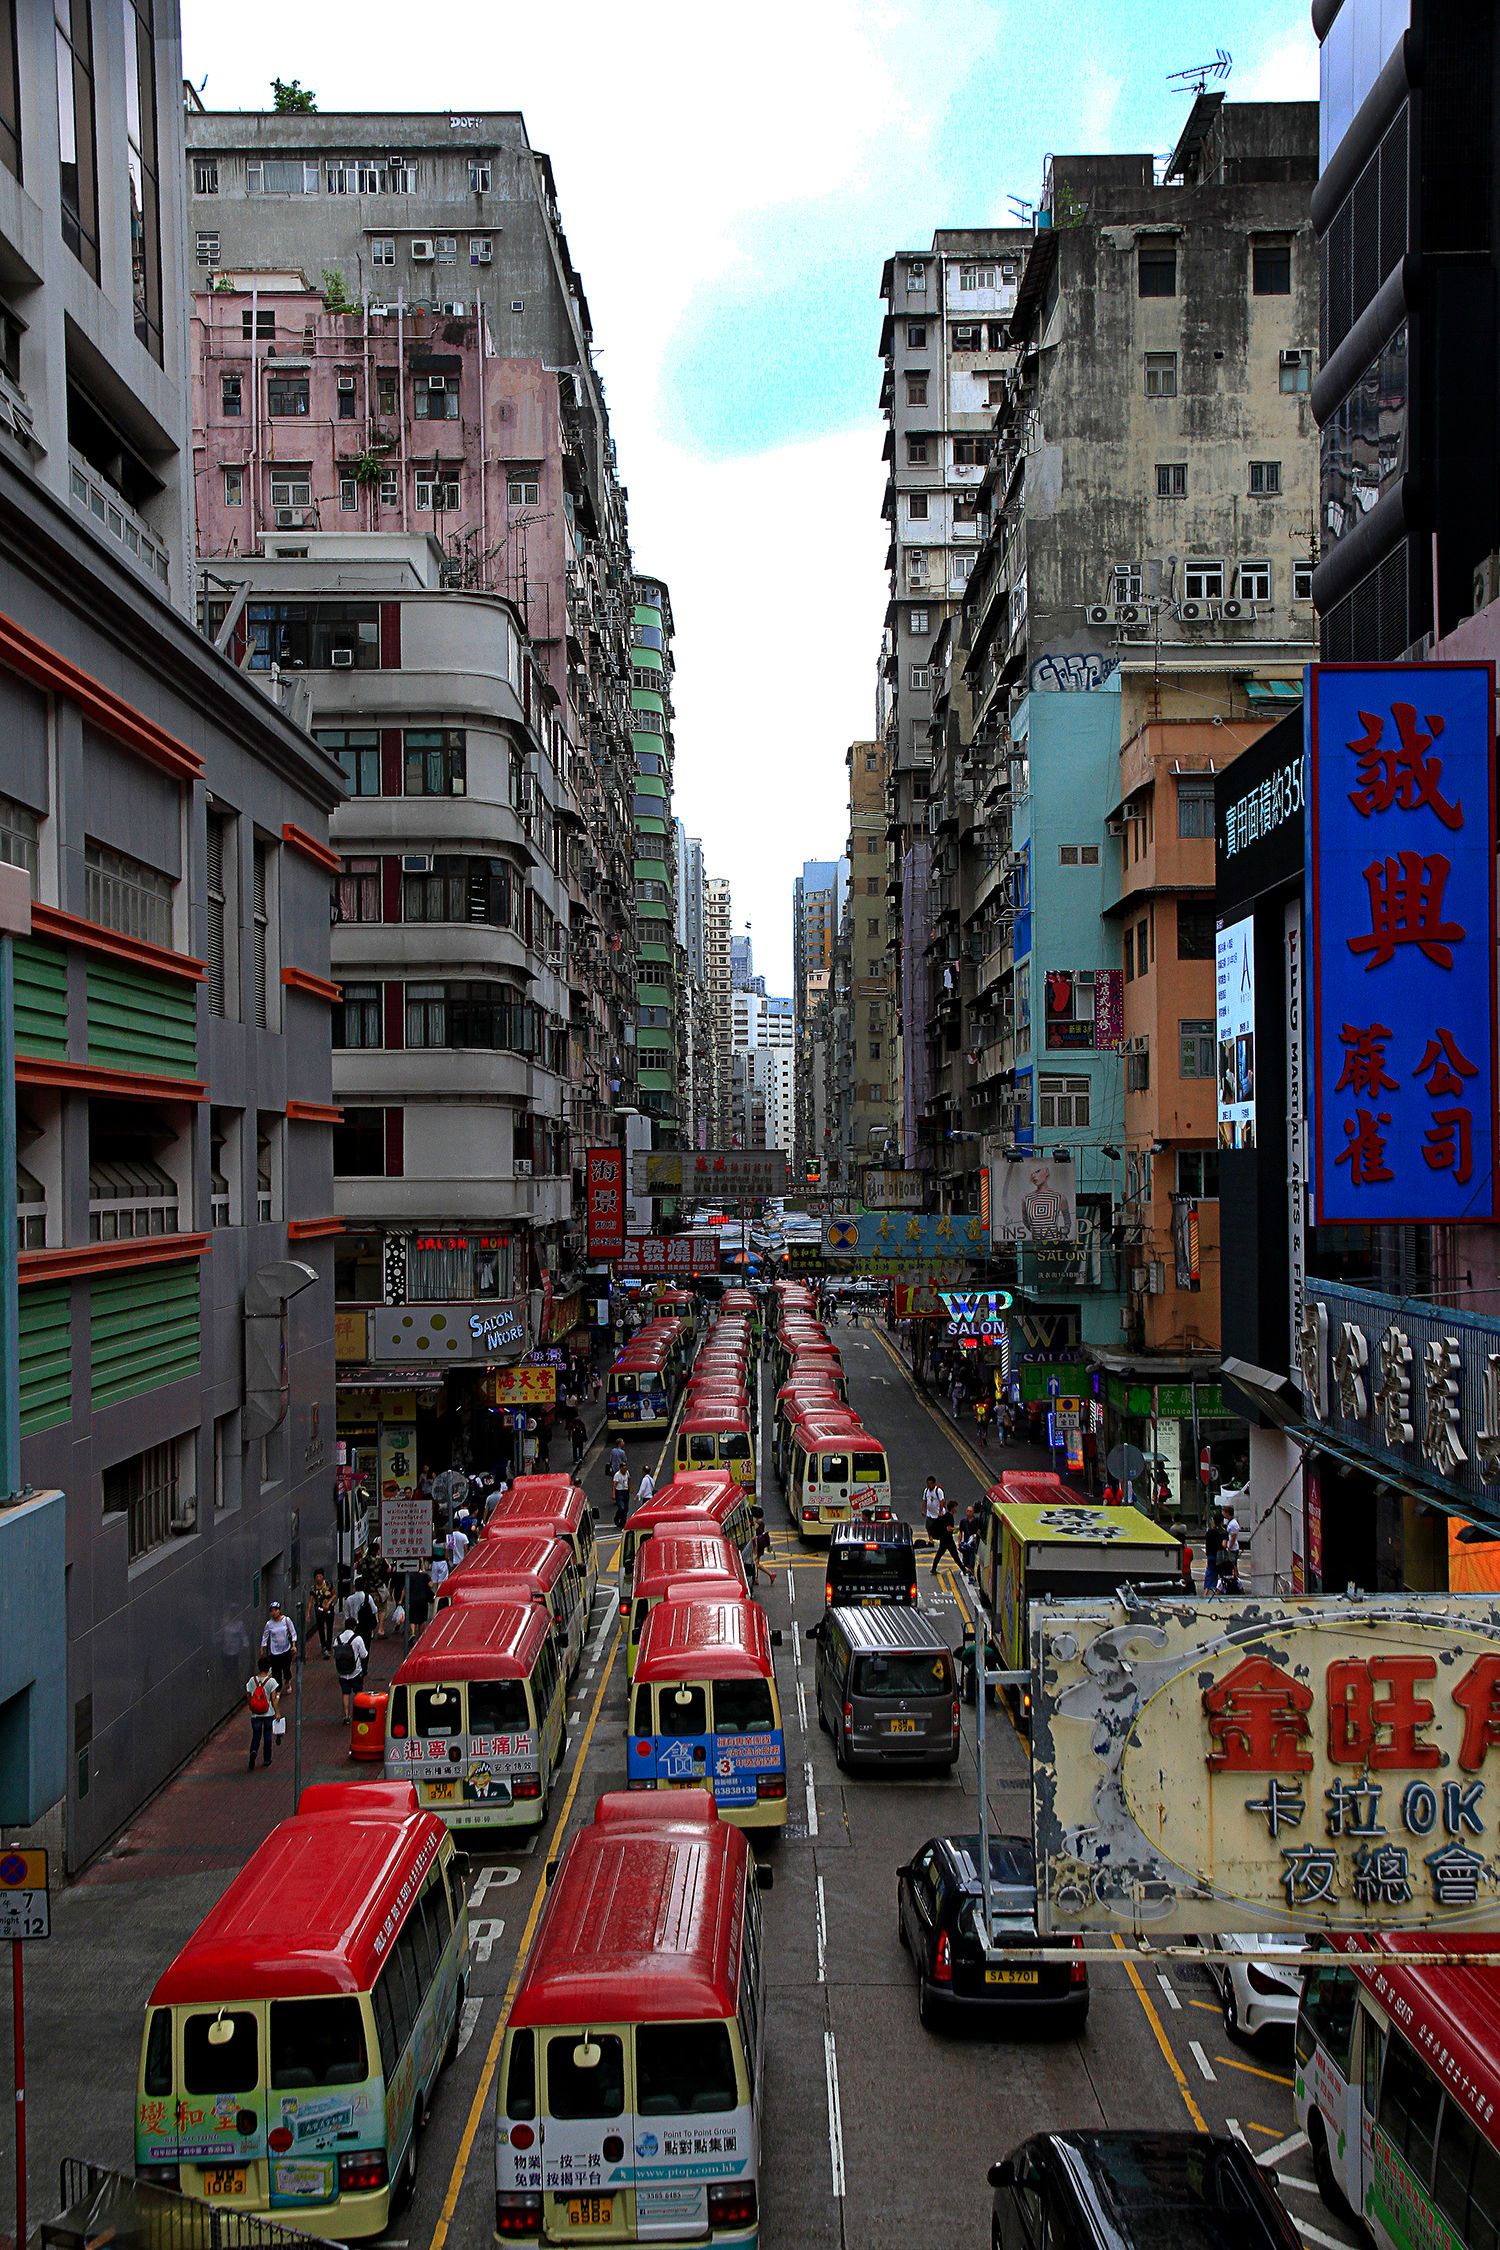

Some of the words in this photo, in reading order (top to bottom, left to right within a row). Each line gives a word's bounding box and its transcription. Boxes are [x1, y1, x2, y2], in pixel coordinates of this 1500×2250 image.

[1291, 1043, 1299, 1152] MARTIAL
[1413, 1028, 1478, 1184] 公司
[591, 1159, 619, 1213] 海景
[649, 1181, 682, 1192] Nikon
[1292, 1161, 1300, 1224] ARTS
[1002, 1226, 1027, 1239] INS
[417, 1237, 468, 1250] SALON
[1037, 1251, 1087, 1261] SALON
[938, 1290, 1013, 1323] WP
[1294, 1263, 1302, 1367] FITNESS
[469, 1310, 514, 1337] SALON
[947, 1321, 1005, 1335] SALON
[487, 1324, 524, 1350] MORE
[498, 1370, 553, 1390] 海天堂
[404, 1740, 446, 1760] 迅寧
[471, 1735, 532, 1757] 止痛片
[1245, 1778, 1486, 1837] 卡拉OK
[1280, 1842, 1485, 1904] 夜總會
[22, 1892, 33, 1908] 7
[24, 1917, 44, 1934] 12
[989, 1972, 1004, 1982] SA
[1008, 1971, 1034, 1982] 5701
[1374, 1973, 1389, 1995] BUS
[1394, 1997, 1414, 2026] SEATS
[685, 2130, 693, 2138] To
[715, 2127, 737, 2137] Group
[664, 2137, 737, 2155] 點對點集團
[636, 2164, 736, 2179] www.ptop.com.hk
[570, 2212, 611, 2223] 6983
